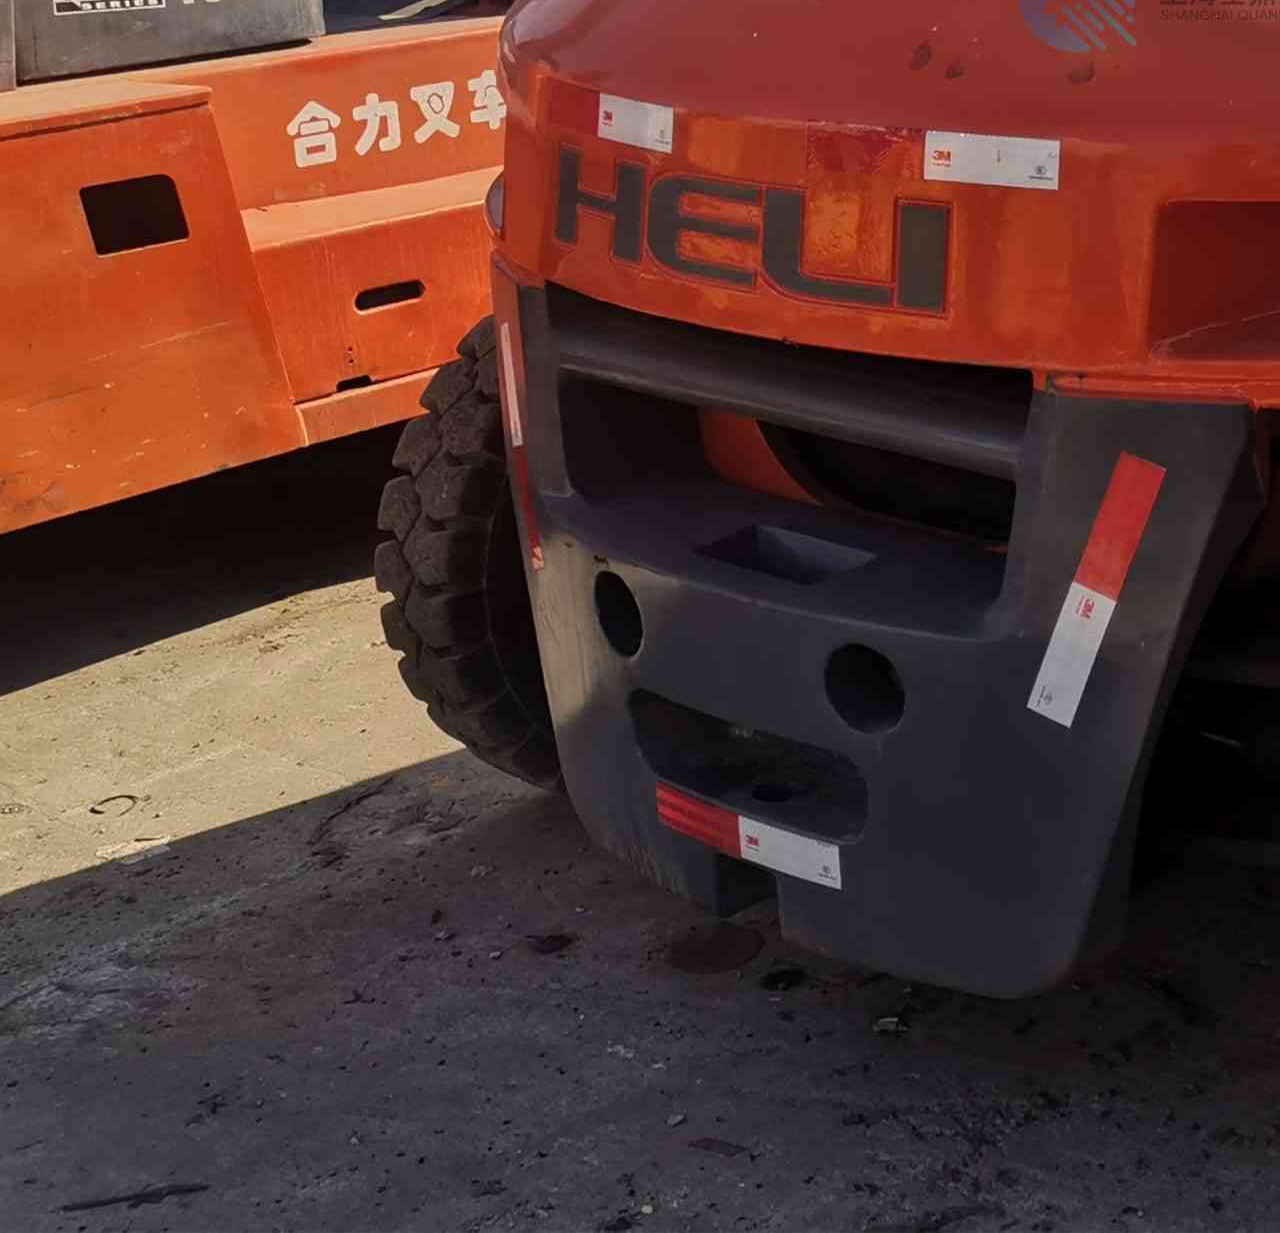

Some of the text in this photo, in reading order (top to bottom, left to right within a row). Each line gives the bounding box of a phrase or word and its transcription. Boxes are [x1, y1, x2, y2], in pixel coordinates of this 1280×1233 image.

[286, 70, 507, 168] 合力叉车
[933, 149, 952, 162] 3M
[555, 144, 951, 315] HELI
[1079, 598, 1094, 620] 3M
[745, 834, 759, 847] 3M
